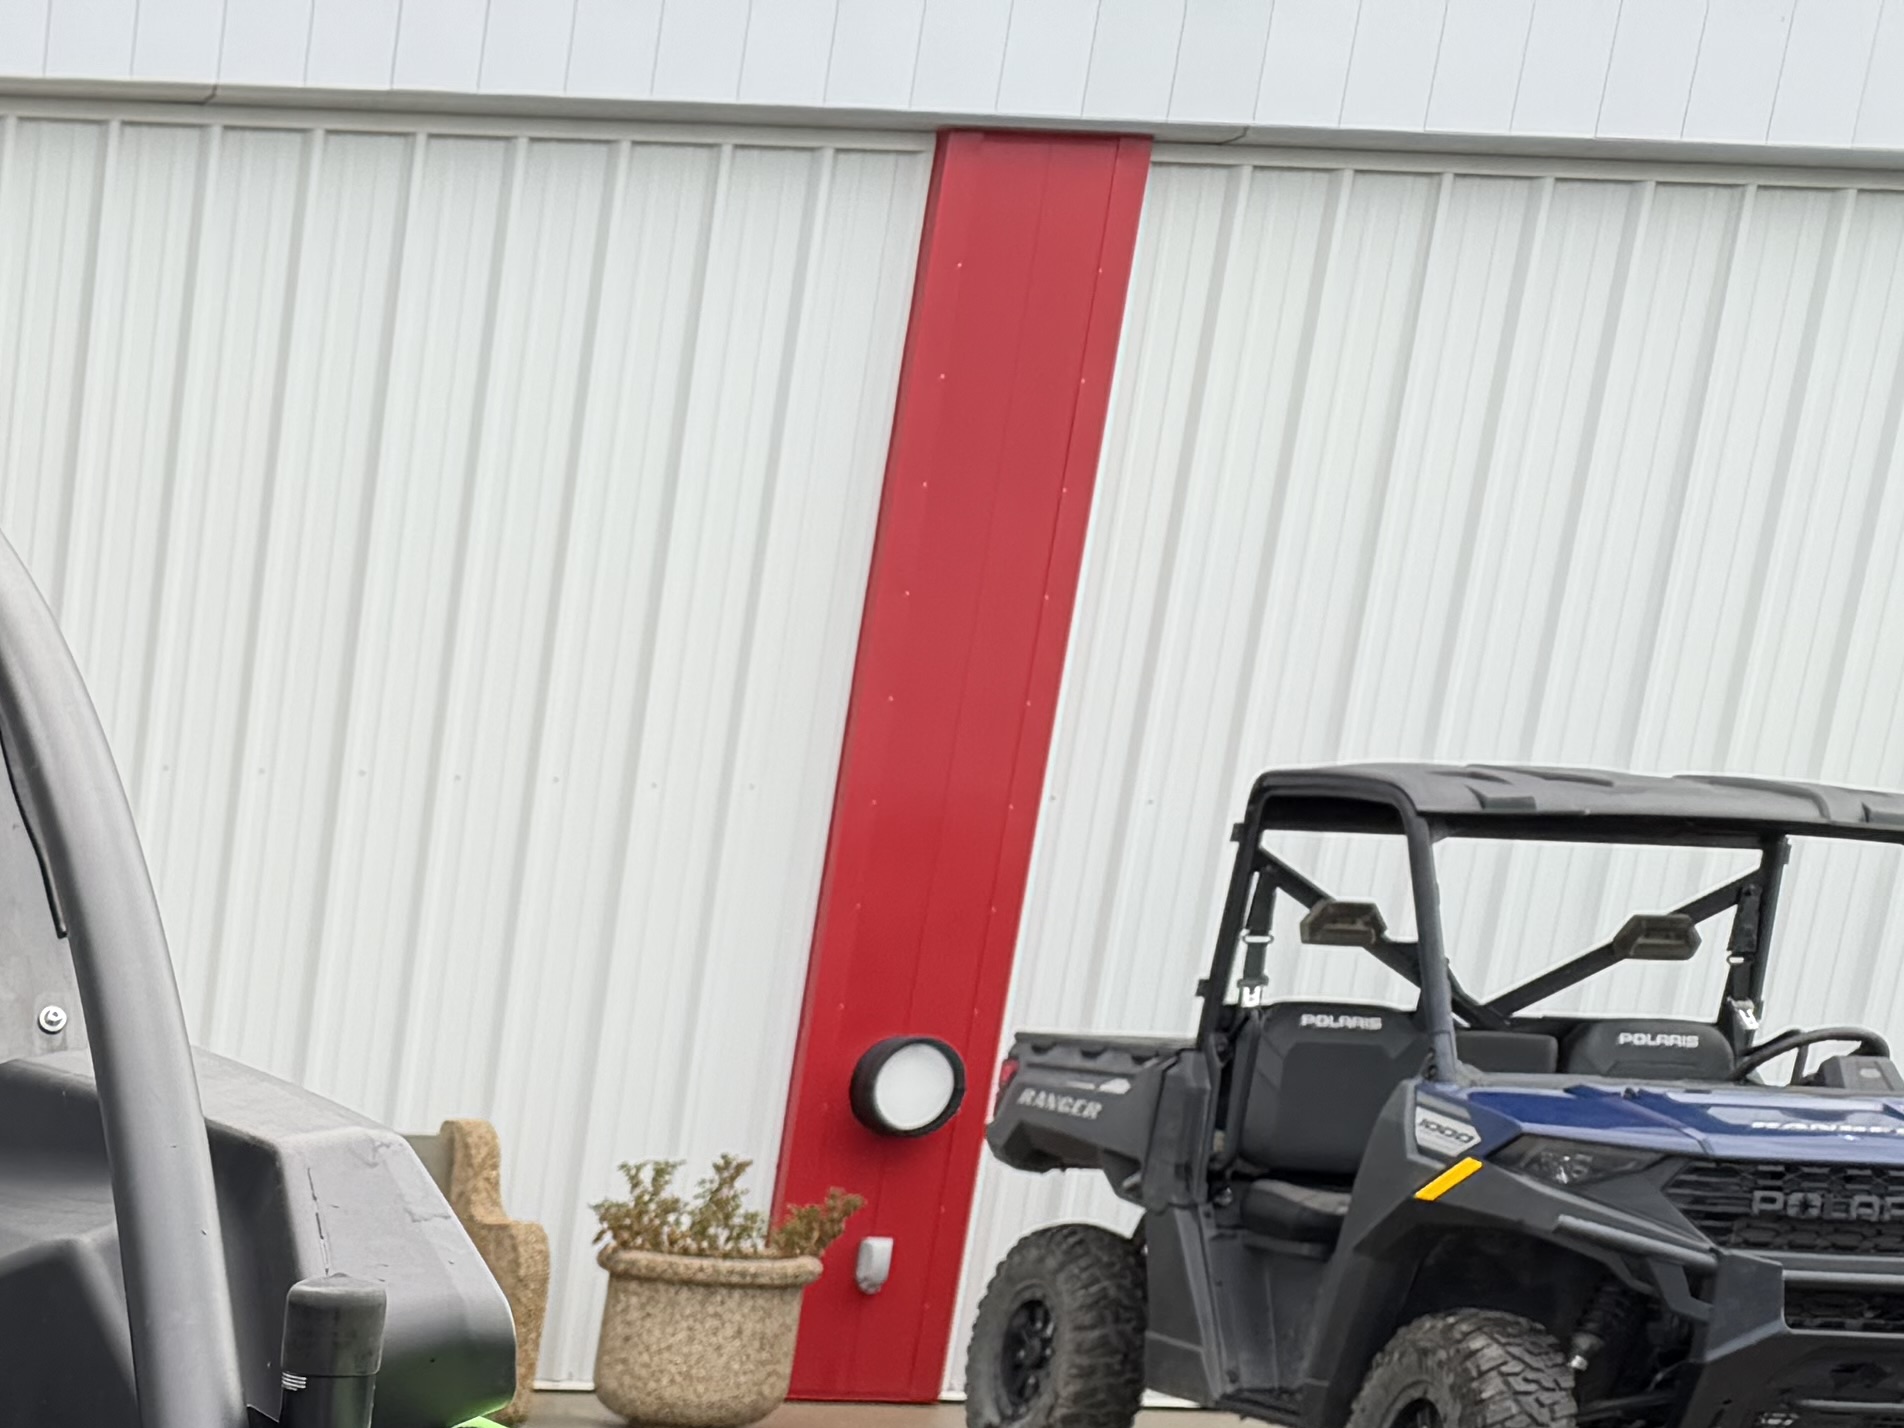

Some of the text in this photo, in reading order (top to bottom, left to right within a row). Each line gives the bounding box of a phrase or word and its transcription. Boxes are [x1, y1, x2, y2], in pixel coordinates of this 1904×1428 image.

[1301, 1013, 1382, 1031] POLARIS
[1617, 1032, 1699, 1048] POLARIS
[1017, 1087, 1102, 1119] RANGER
[1419, 1119, 1474, 1143] 1000
